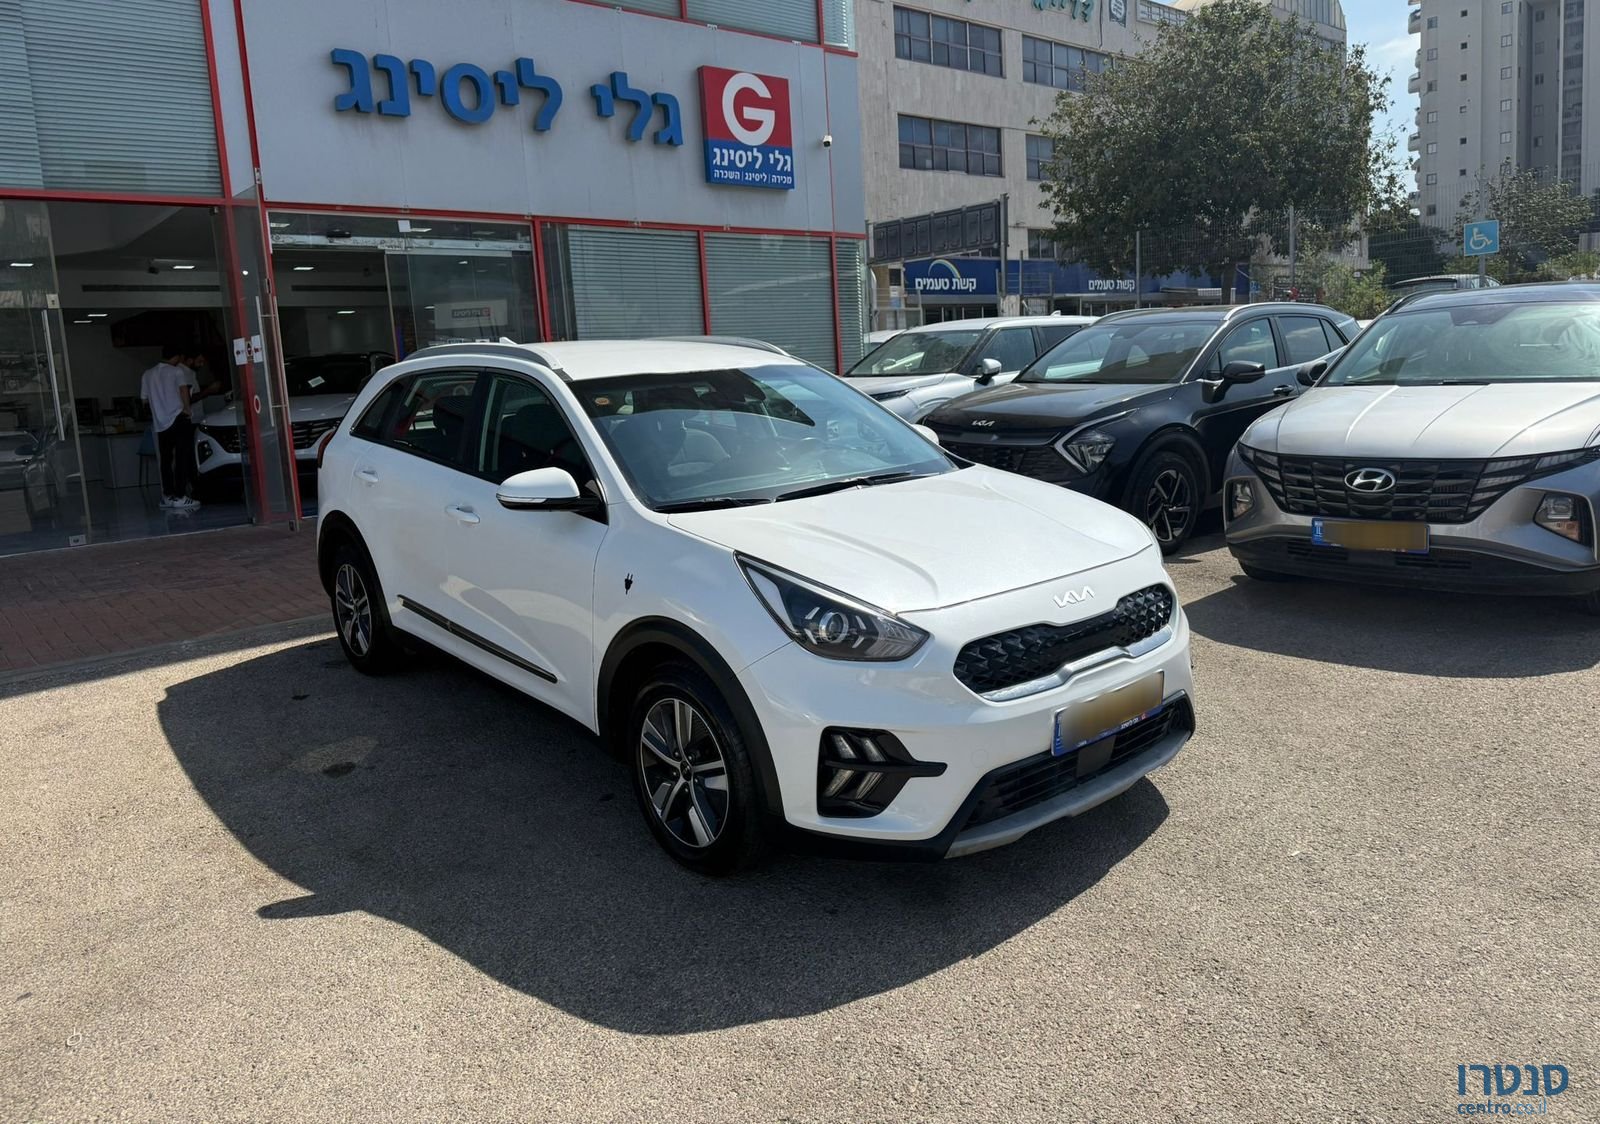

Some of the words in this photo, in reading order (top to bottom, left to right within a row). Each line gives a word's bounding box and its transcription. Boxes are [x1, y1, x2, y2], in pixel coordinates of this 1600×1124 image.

[330, 47, 563, 133] ליסינג
[590, 71, 684, 147] גלי
[722, 72, 776, 146] G
[712, 147, 763, 170] ליסינג
[768, 149, 792, 173] גלי
[714, 169, 741, 181] השכרה
[744, 171, 767, 182] ליסינג
[771, 174, 792, 185] מכירה
[914, 277, 950, 291] טעמים
[951, 277, 977, 293] קשת
[1088, 279, 1115, 291] טעמים
[1116, 279, 1136, 293] קשת
[1052, 585, 1096, 609] KIA
